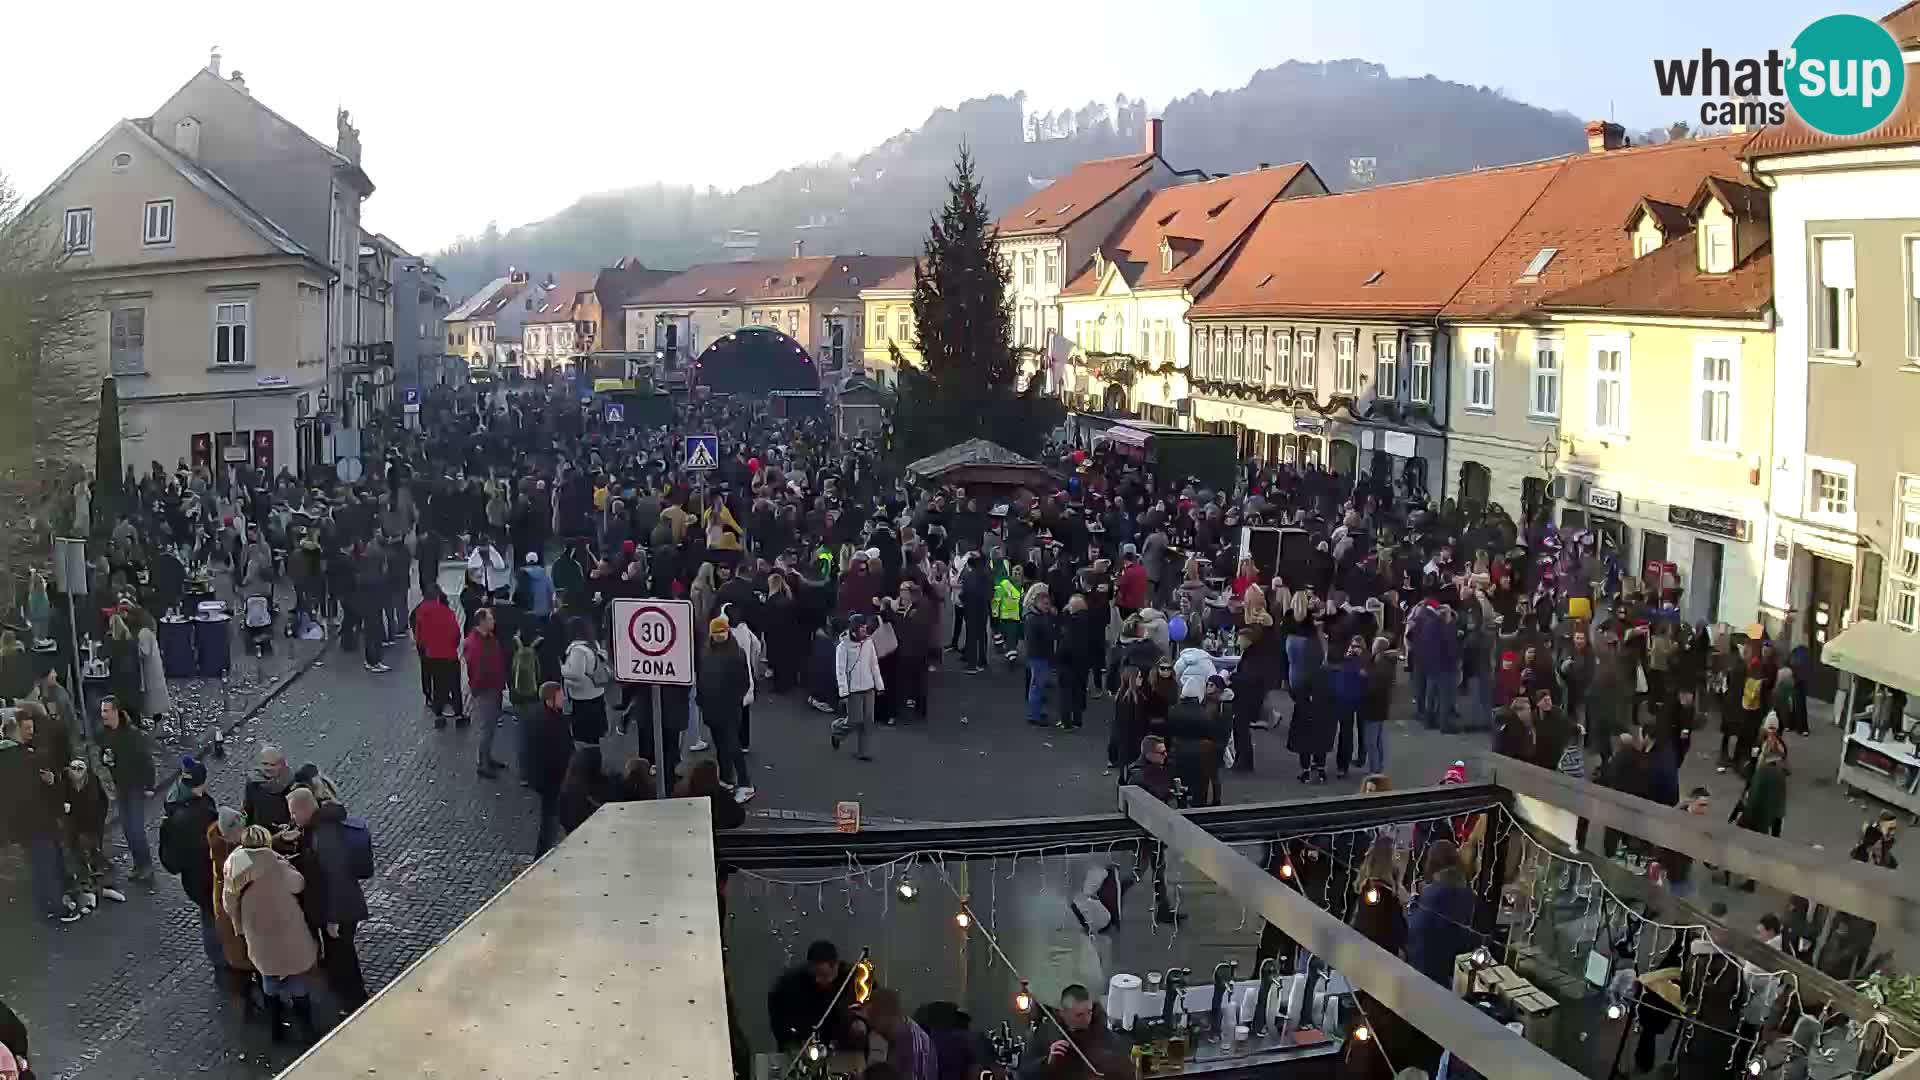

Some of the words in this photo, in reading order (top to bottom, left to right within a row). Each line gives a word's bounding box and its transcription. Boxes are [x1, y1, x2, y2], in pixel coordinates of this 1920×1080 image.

[407, 391, 416, 401] P
[641, 622, 665, 643] 30
[631, 659, 676, 677] ZONA
